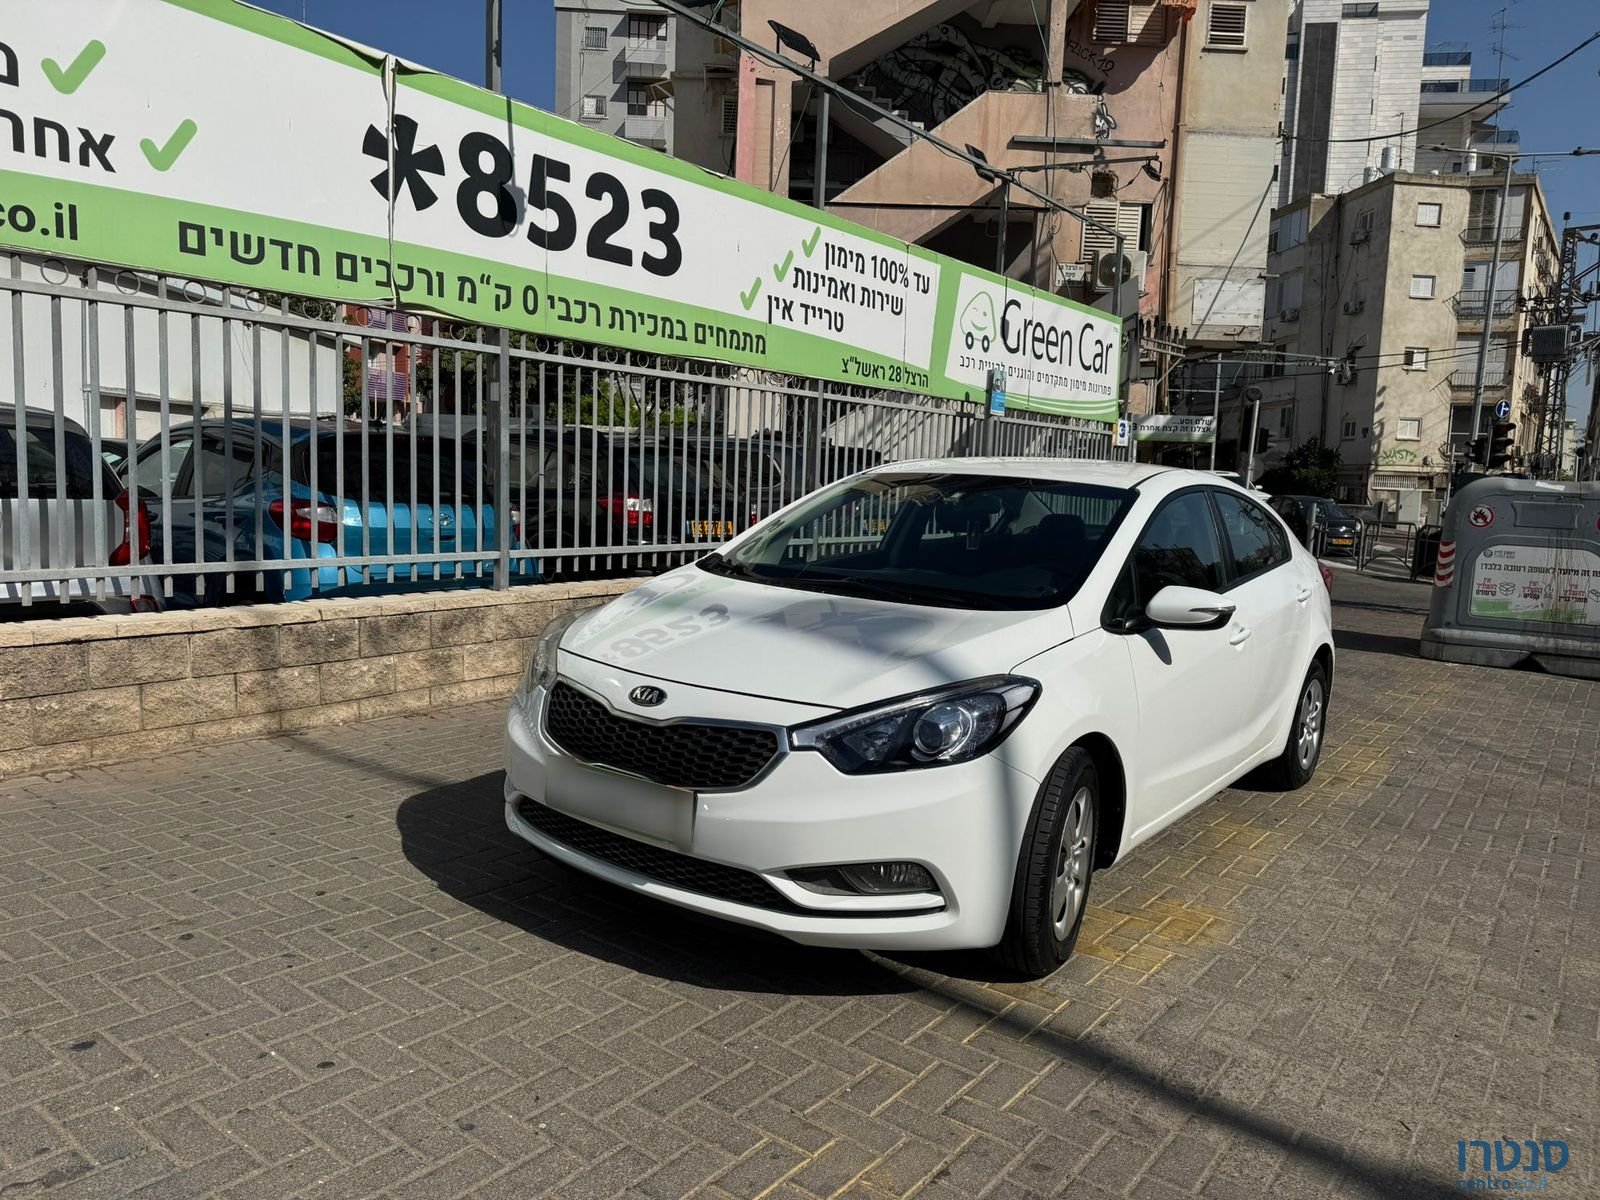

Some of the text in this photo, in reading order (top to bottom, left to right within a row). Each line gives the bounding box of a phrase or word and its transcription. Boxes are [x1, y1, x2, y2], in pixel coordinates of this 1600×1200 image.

[178, 220, 321, 277] חדשים
[335, 250, 445, 298] ורכבים
[824, 241, 931, 295] עד 100% מימון
[522, 285, 539, 316] 0
[792, 265, 904, 316] שירות ואמינות
[547, 294, 601, 327] רכבי
[608, 306, 688, 342] במכירת
[767, 294, 845, 333] טרייד אין
[694, 321, 767, 356] מתמחים
[1002, 299, 1113, 375] Green Car
[888, 364, 903, 384] 28
[903, 366, 930, 388] הרצל
[959, 354, 976, 370] רכב
[1036, 372, 1068, 389] מתקדמים
[1070, 377, 1087, 391] מימון
[1140, 424, 1160, 432] אחרת
[1162, 424, 1178, 434] קצת
[631, 687, 661, 703] KIA
